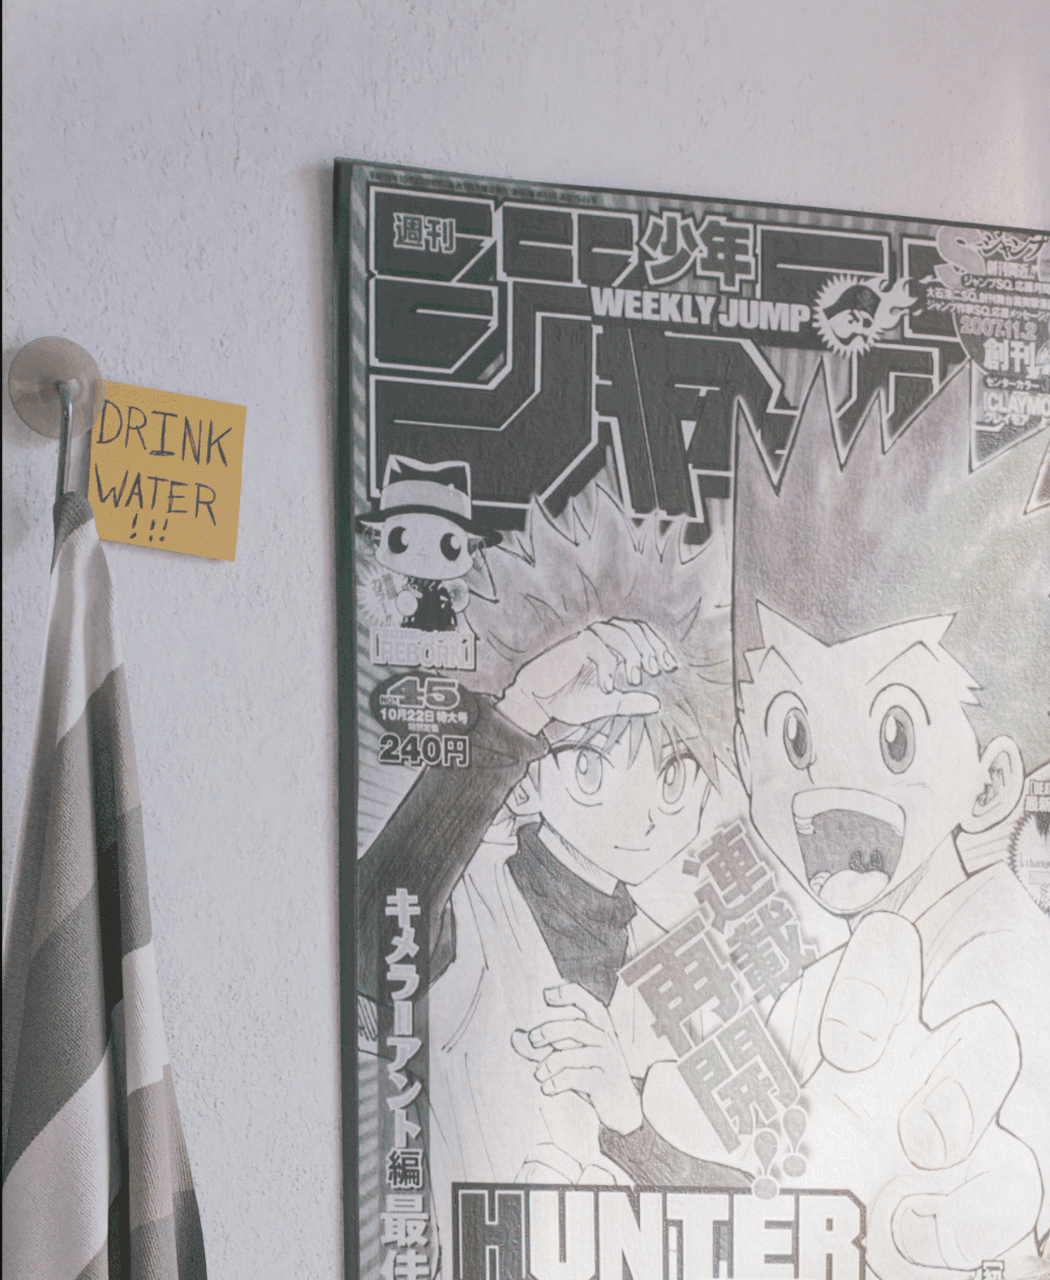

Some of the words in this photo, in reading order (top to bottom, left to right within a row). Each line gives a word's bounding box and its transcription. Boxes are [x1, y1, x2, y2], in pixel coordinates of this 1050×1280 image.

[393, 213, 456, 253] 週刊
[640, 211, 755, 293] 少年
[590, 287, 717, 325] WEEKLY
[718, 301, 811, 333] JUMP
[960, 315, 1038, 341] 2007.11.2
[982, 338, 1037, 373] 創刊
[96, 399, 232, 468] DRINK
[95, 462, 216, 527] WATER
[130, 513, 168, 542] !!!
[387, 677, 461, 710] 45
[380, 709, 434, 722] 10月22日
[379, 733, 469, 768] 240円
